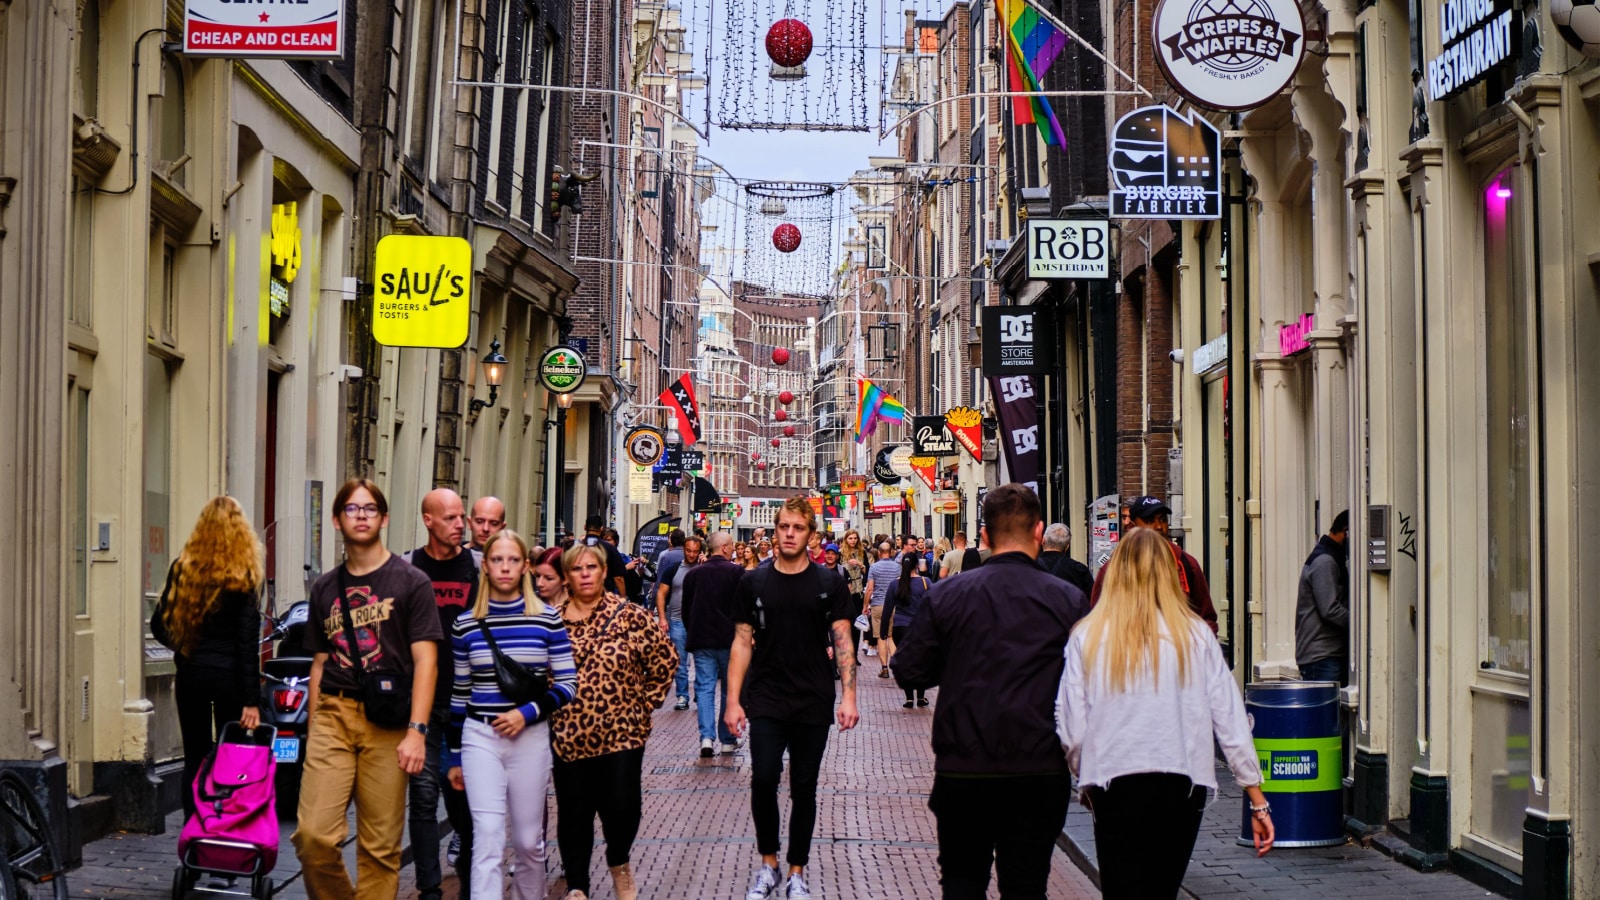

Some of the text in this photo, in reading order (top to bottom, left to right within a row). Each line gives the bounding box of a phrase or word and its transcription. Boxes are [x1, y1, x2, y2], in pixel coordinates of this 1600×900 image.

[1189, 19, 1275, 40] CREPES &
[191, 32, 332, 46] CHEAP AND CLEAN
[1186, 36, 1280, 60] WAFFLES
[1429, 8, 1513, 101] RESTAURANT
[1203, 66, 1266, 80] FRESHLY BAKED
[1125, 185, 1206, 200] BURGER
[1125, 200, 1206, 213] FABRIEK
[1033, 263, 1104, 272] AMSTERDAM
[381, 264, 464, 306] SAUL'S
[380, 302, 420, 311] BURGERS
[380, 311, 409, 319] TOSTIS
[1000, 314, 1034, 342] DC
[1001, 348, 1034, 357] STORE
[543, 364, 580, 374] Heineken
[1000, 375, 1034, 403] DC
[923, 442, 953, 451] STEAK
[956, 428, 979, 452] DONNY
[326, 604, 386, 632] HAR ROCK
[279, 740, 297, 749] DPV
[279, 749, 296, 758] 33N
